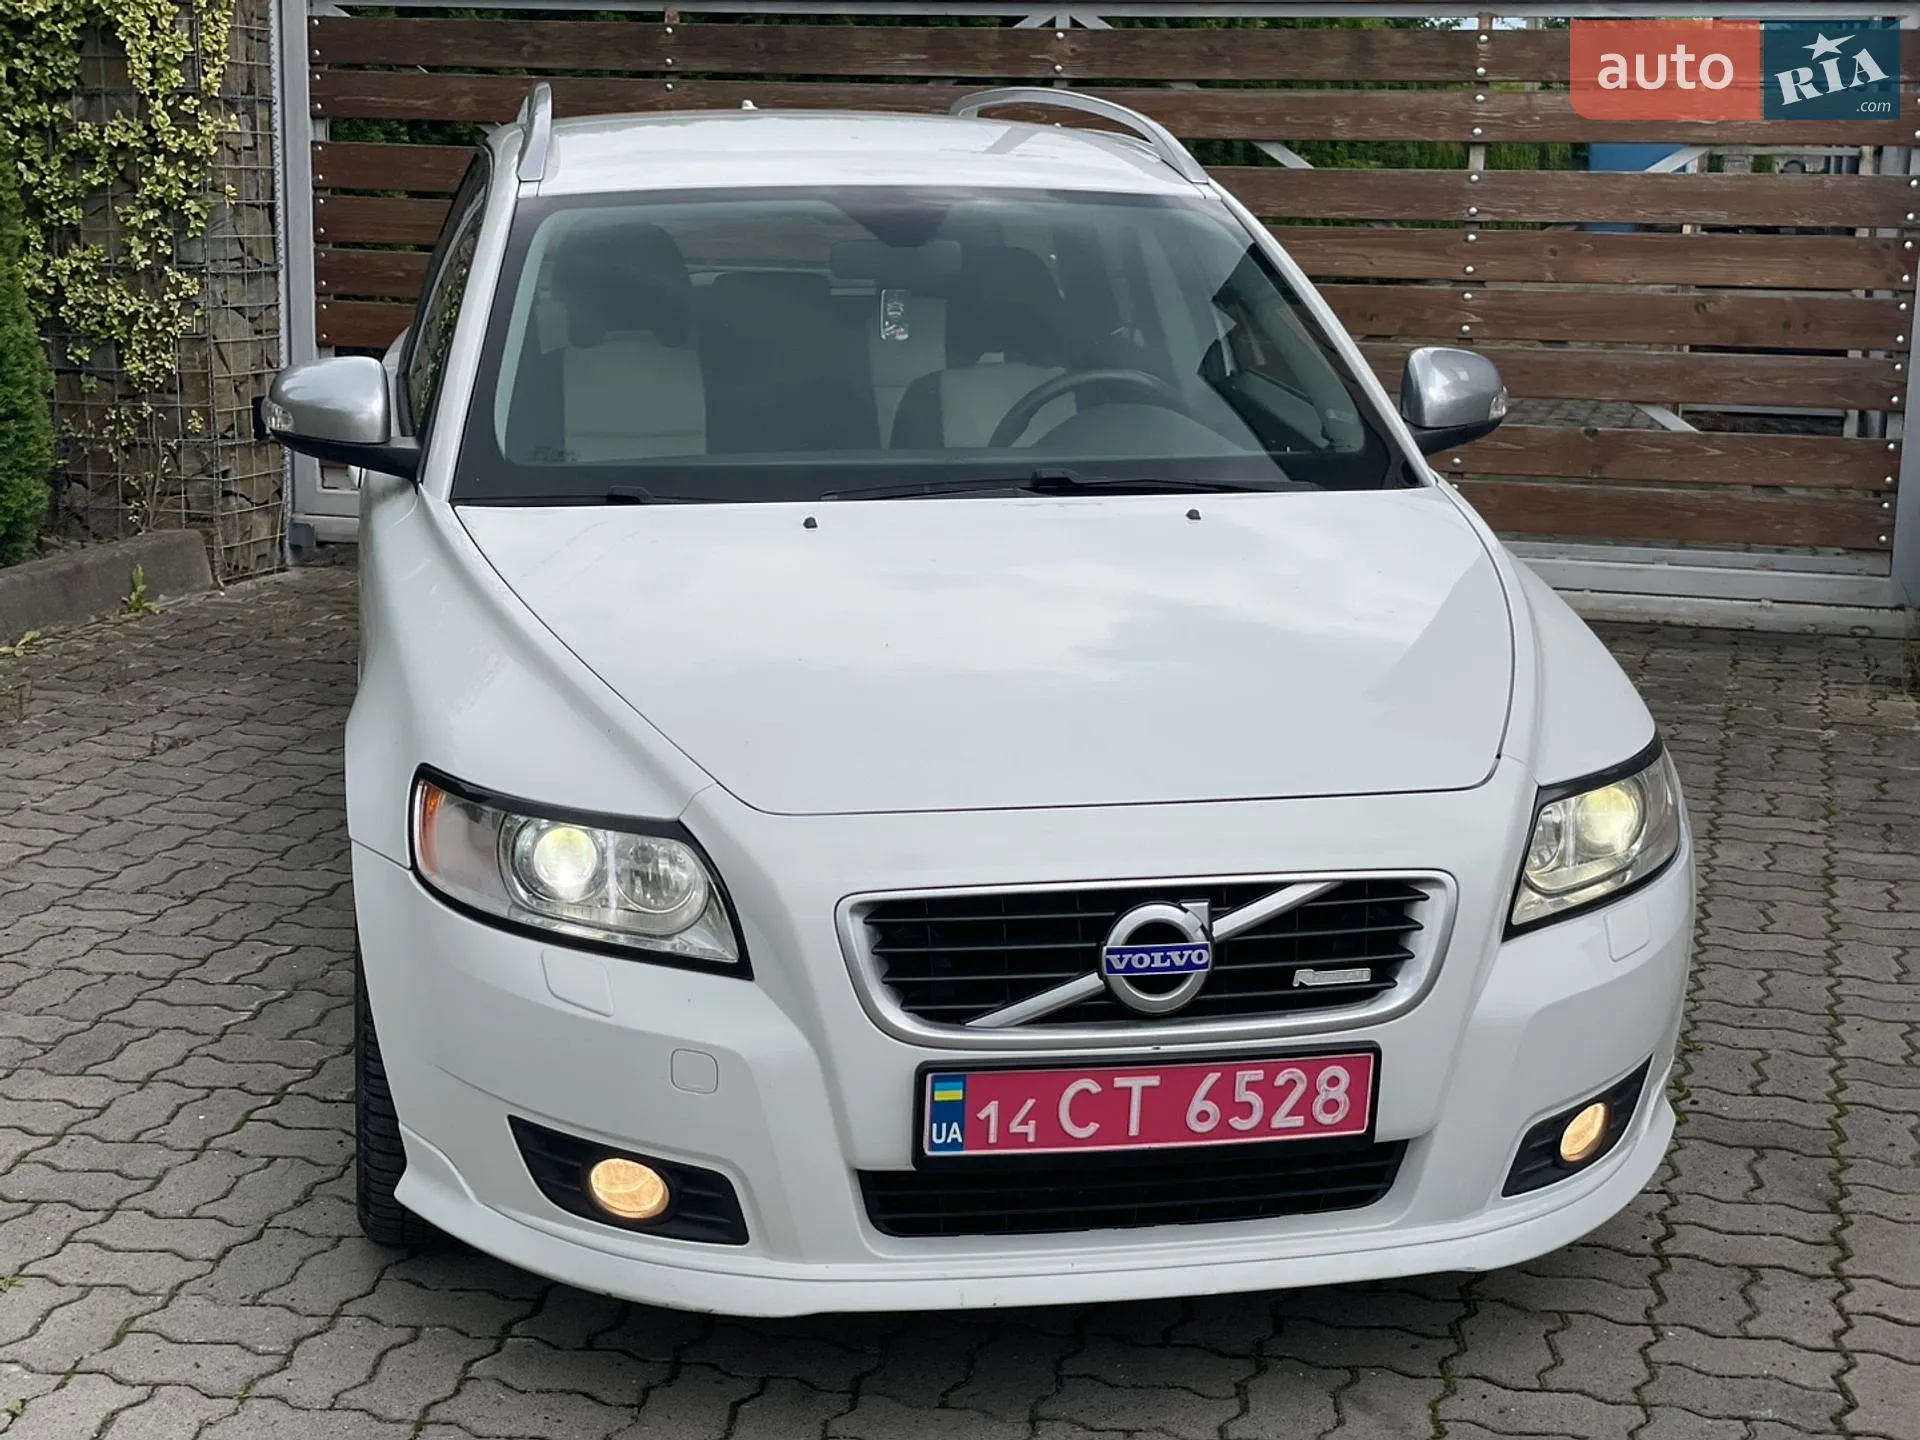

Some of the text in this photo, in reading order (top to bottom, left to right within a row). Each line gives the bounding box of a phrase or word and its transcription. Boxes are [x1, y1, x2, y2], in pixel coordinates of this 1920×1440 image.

[1105, 949, 1210, 970] VOLVO
[976, 1065, 1351, 1144] 14 CT 6528
[931, 1121, 963, 1145] UA
